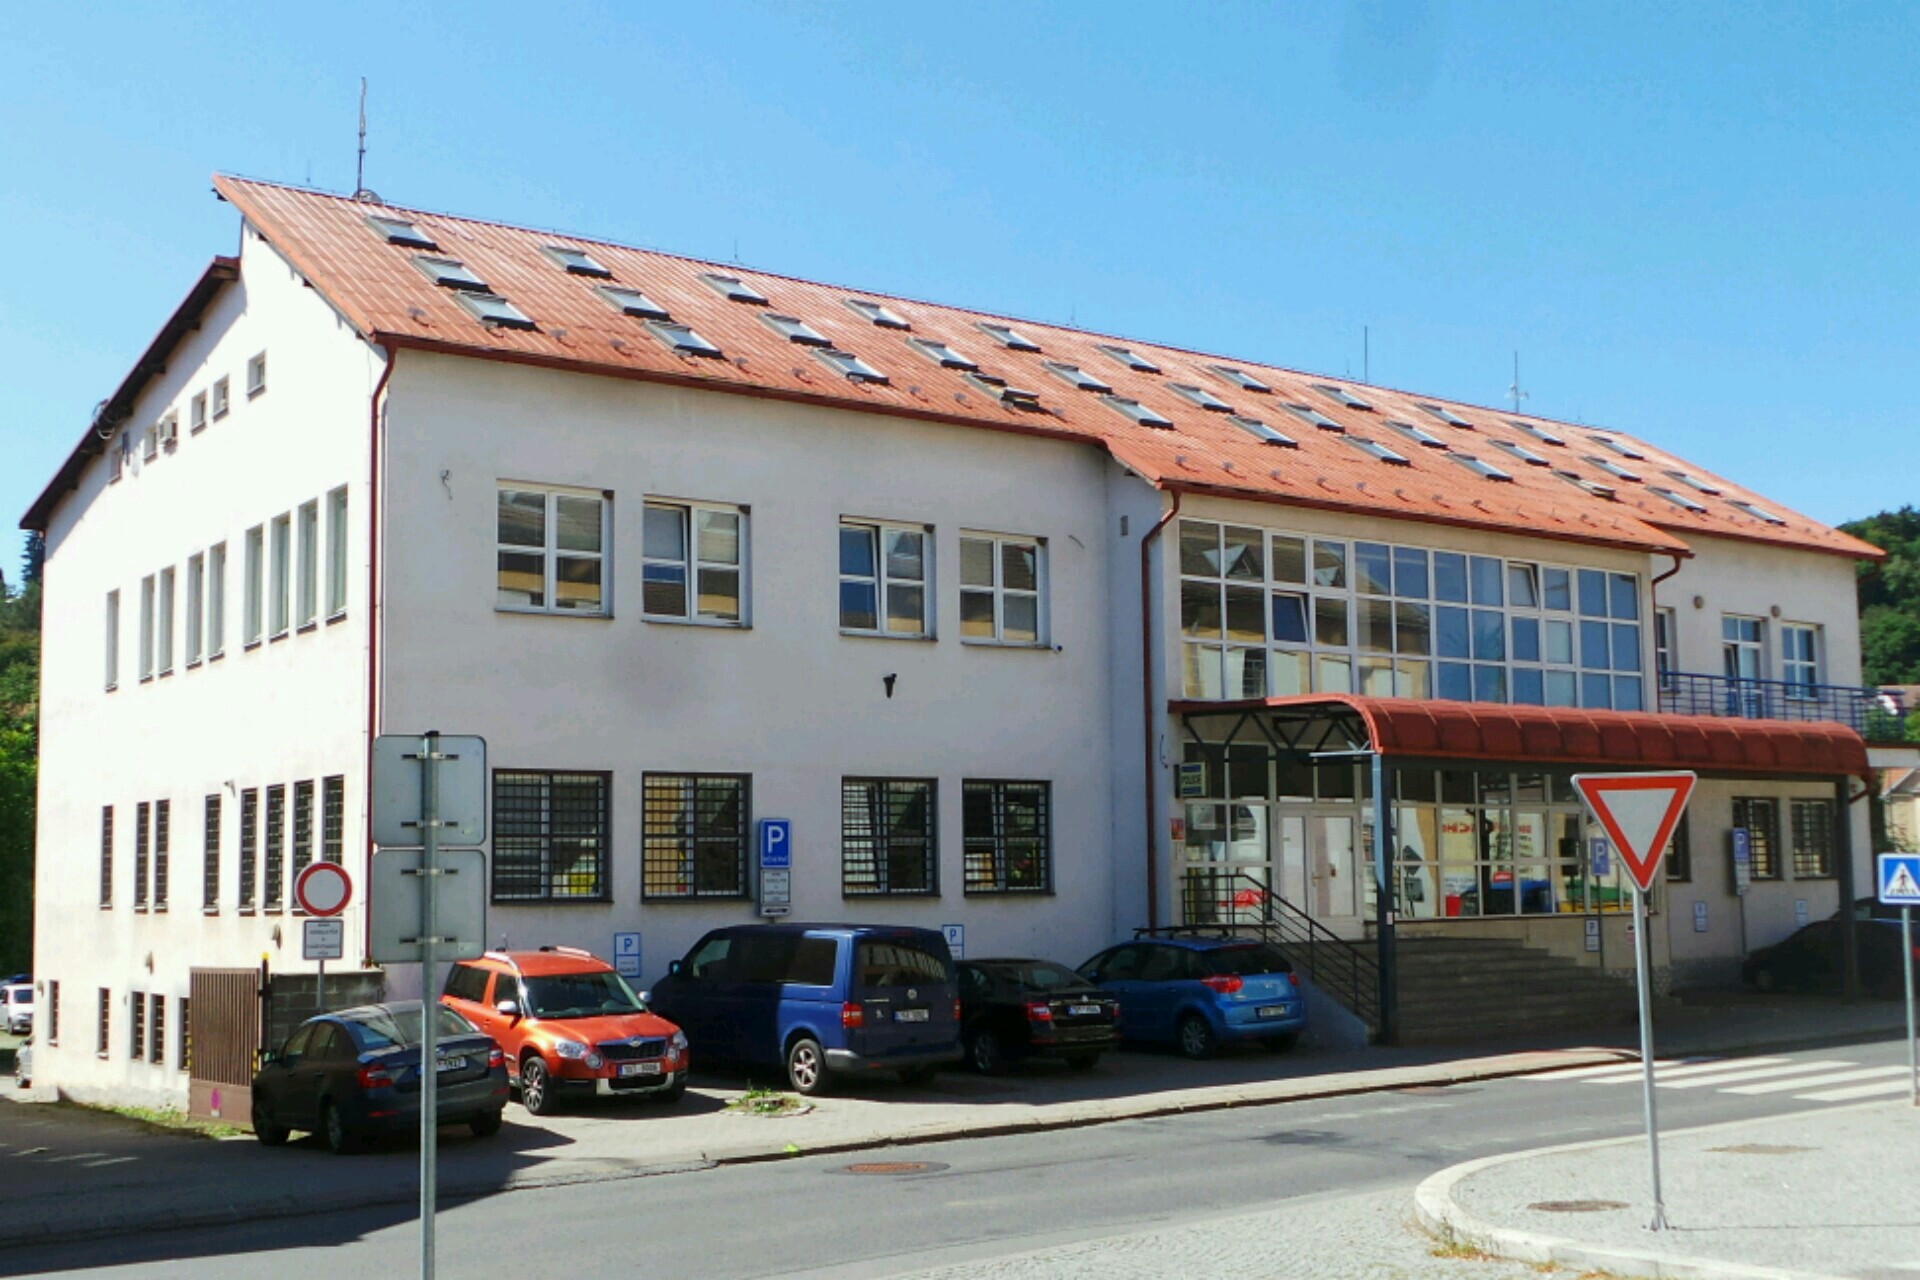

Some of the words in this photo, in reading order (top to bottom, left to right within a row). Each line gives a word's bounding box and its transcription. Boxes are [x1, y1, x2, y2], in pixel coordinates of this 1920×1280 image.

[768, 825, 785, 854] P
[1595, 843, 1606, 864] P
[950, 927, 957, 942] P
[624, 938, 633, 952] P
